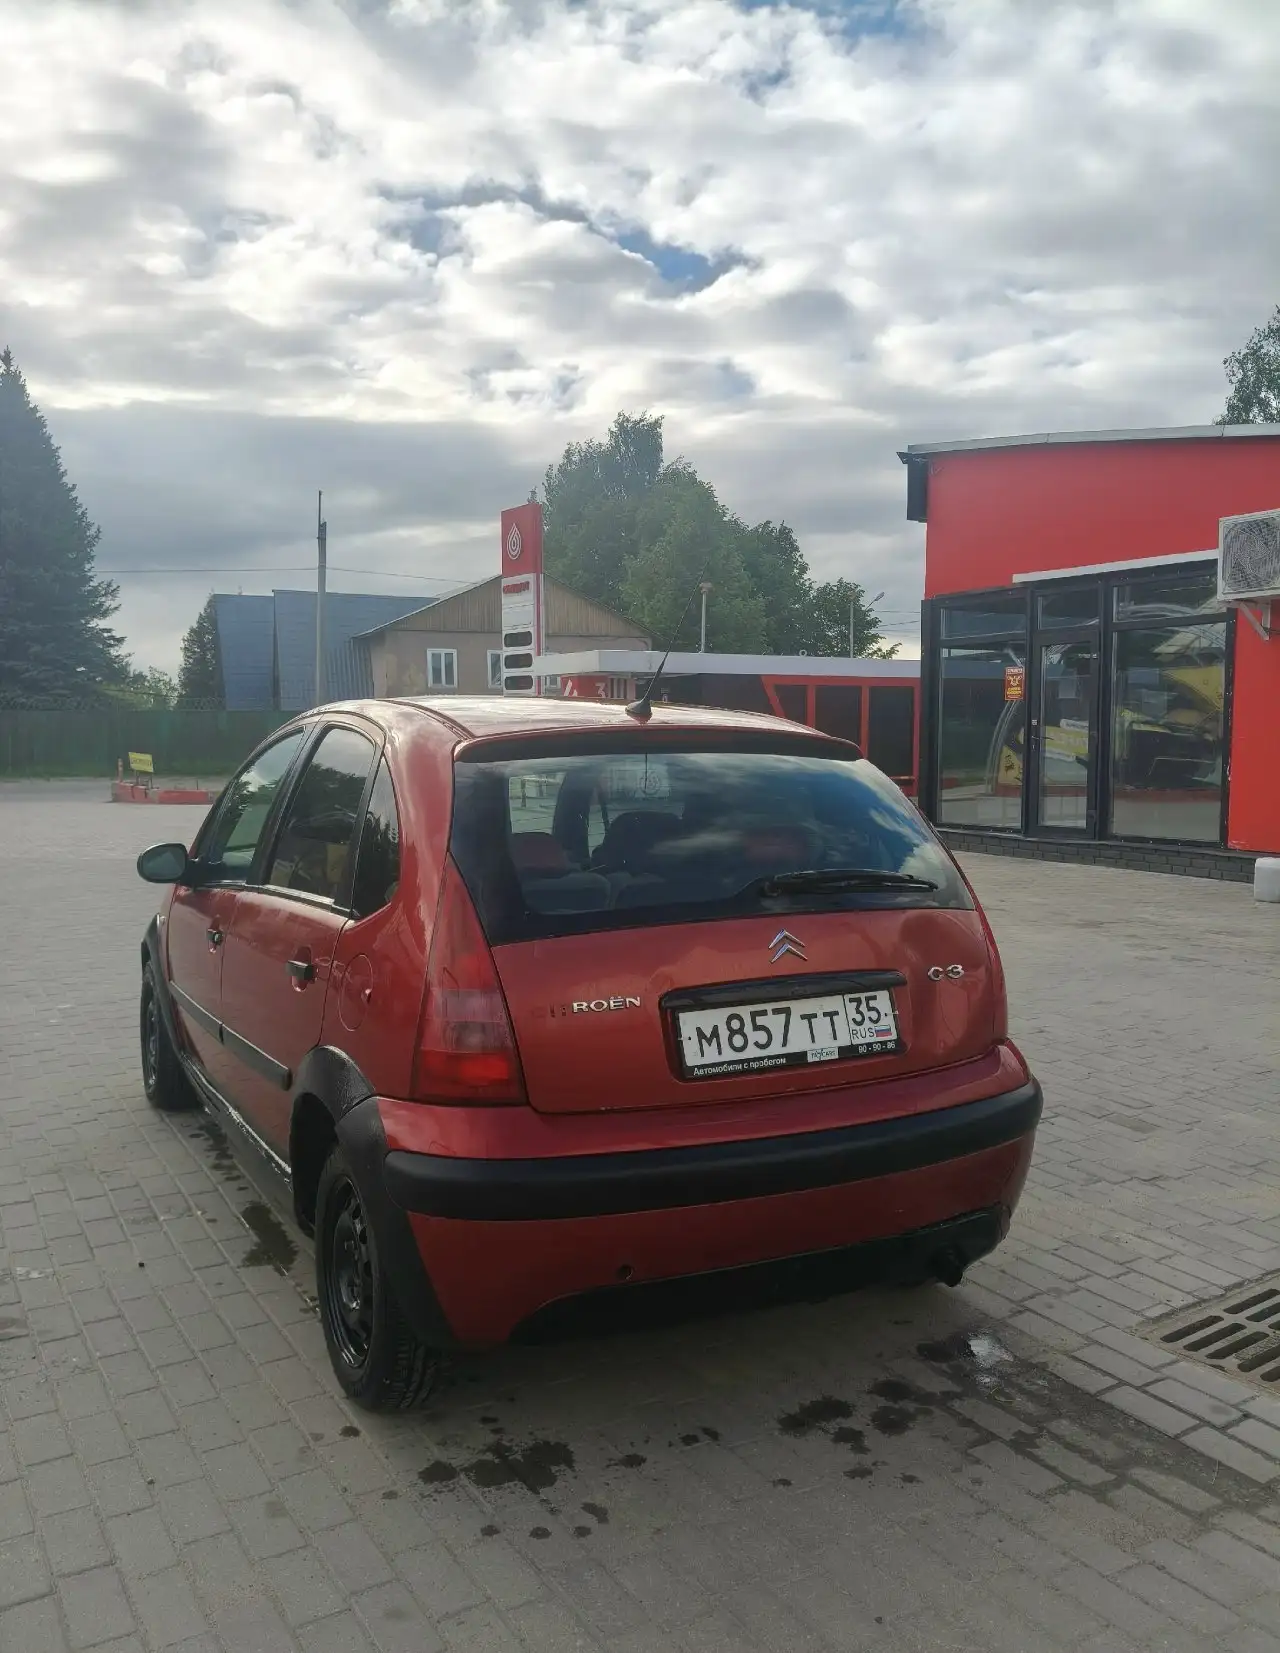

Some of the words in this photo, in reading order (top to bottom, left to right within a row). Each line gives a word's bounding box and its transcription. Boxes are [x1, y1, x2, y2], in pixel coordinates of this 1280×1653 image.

[928, 964, 965, 981] C3
[848, 995, 882, 1027] 35
[851, 1027, 875, 1046] RUS
[693, 1063, 742, 1076] Автомобили
[749, 1057, 786, 1069] пробегом
